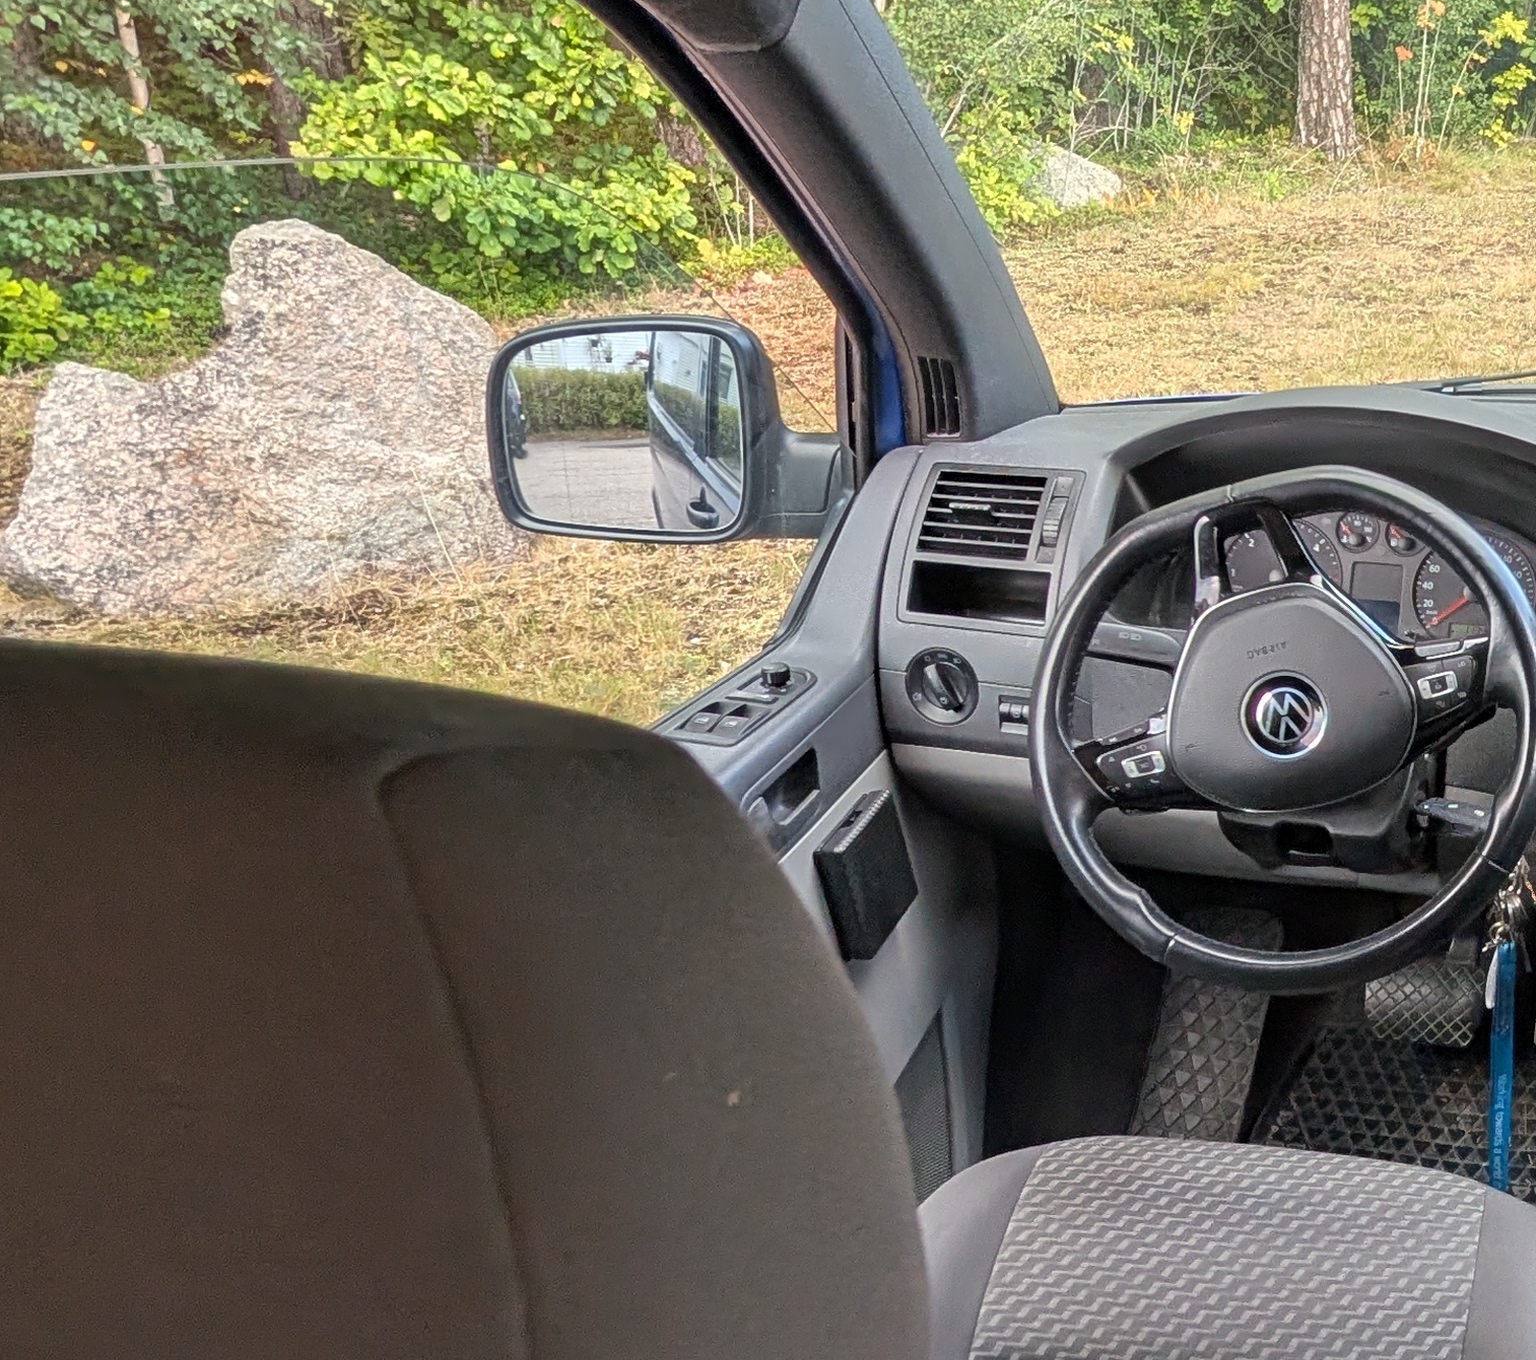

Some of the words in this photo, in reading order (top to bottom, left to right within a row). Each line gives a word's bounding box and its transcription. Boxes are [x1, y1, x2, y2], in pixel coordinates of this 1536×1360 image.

[1248, 538, 1255, 548] 2
[1429, 564, 1440, 573] 60
[1422, 581, 1434, 590] 40
[1423, 598, 1434, 608] 20
[1246, 641, 1287, 660] AIRBAG
[1494, 1111, 1504, 1146] towards
